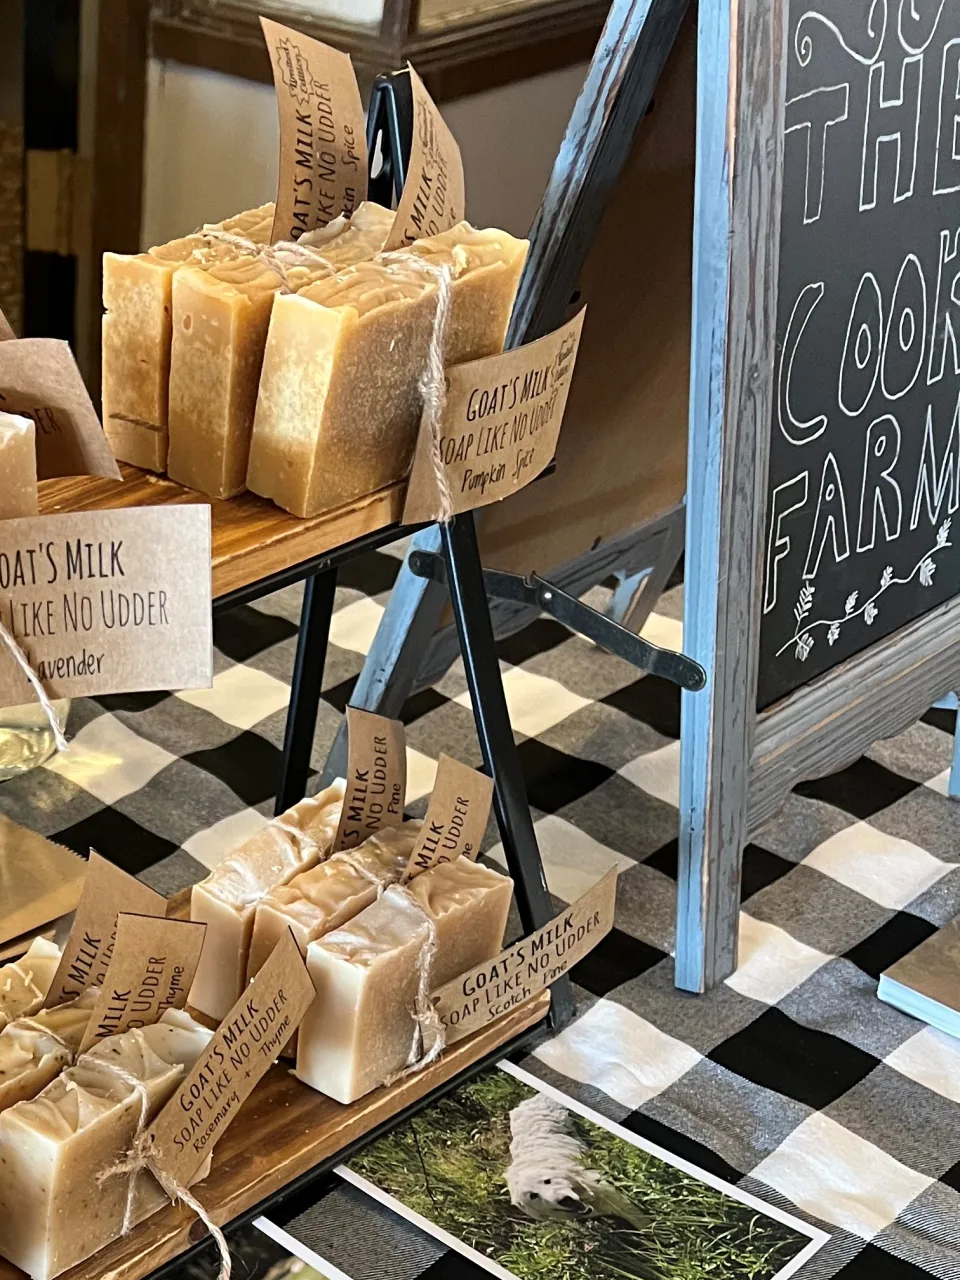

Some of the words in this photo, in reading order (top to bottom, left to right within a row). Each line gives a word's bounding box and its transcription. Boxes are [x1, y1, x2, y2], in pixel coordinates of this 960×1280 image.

[295, 108, 314, 170] MILK
[313, 80, 336, 144] UDDER
[318, 152, 337, 183] NO
[341, 124, 361, 172] Spice
[291, 175, 314, 242] OAT'S
[410, 167, 433, 231] MILK
[466, 376, 520, 422] GOAT'S
[520, 364, 552, 402] MILK
[439, 433, 474, 466] SOAP
[476, 422, 509, 457] LIKE
[509, 411, 528, 445] NO
[461, 463, 506, 495] Pumpkin
[512, 447, 536, 480] Spice
[66, 538, 125, 581] MILK
[9, 598, 56, 640] LIKE
[63, 592, 93, 633] NO
[100, 589, 169, 629] UDDER
[370, 736, 387, 795] UDDER
[347, 768, 369, 822] MILK
[365, 803, 384, 830] NO
[387, 783, 401, 815] Pine
[414, 820, 445, 869] MILK
[442, 796, 470, 850] UDDER
[68, 931, 102, 986] MILK
[440, 997, 480, 1031] SOAP
[485, 970, 523, 1005] LIKE
[527, 952, 550, 979] NO
[555, 911, 601, 957] UDDER
[462, 946, 526, 997] GOAT'S
[531, 912, 574, 956] MILK
[130, 956, 167, 1012] UDDER
[156, 966, 185, 1015] Thyme
[486, 986, 532, 1022] Scotch
[542, 960, 568, 985] Pine
[95, 989, 132, 1039] MILK
[173, 1107, 204, 1153] SOAP
[203, 1068, 233, 1110] LIKE
[230, 1042, 251, 1071] NO
[249, 988, 288, 1043] UDDER
[180, 1045, 225, 1113] GOAT'S
[222, 999, 260, 1050] MILK
[193, 1090, 241, 1153] Rosemary
[258, 1014, 291, 1058] Thyme
